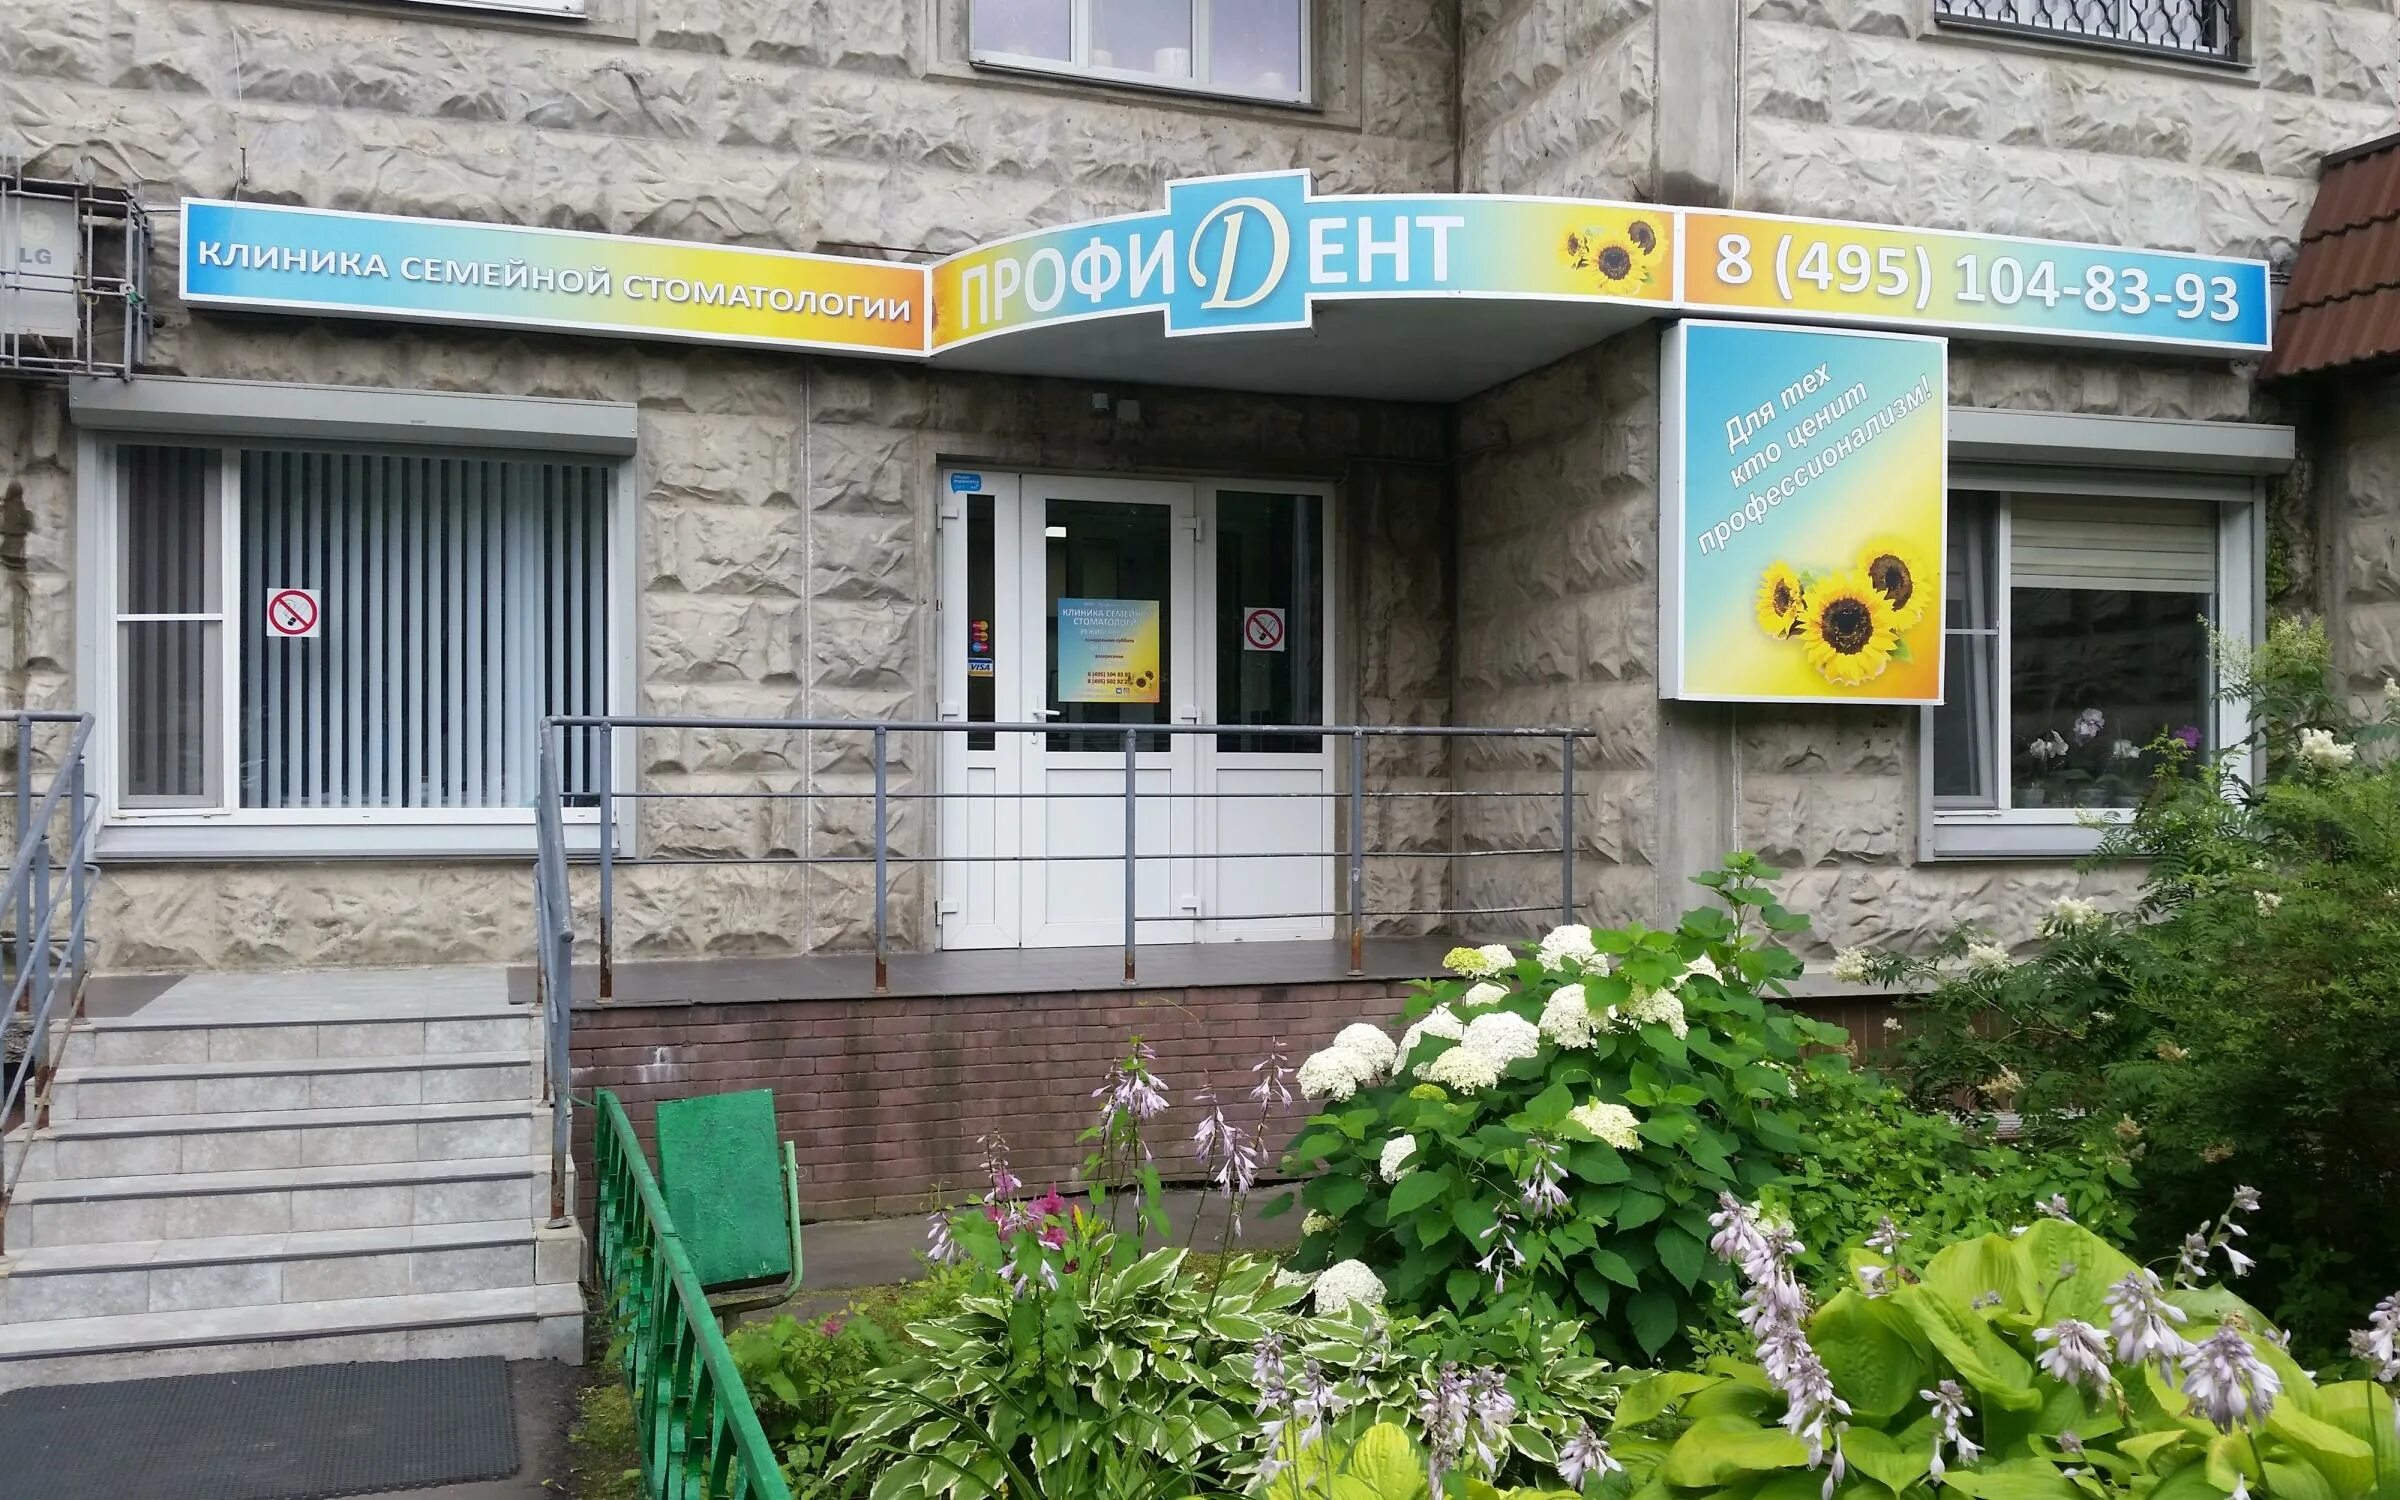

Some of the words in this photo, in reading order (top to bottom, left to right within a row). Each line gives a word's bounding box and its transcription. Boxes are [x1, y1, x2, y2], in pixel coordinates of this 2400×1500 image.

[19, 247, 52, 264] LG
[199, 241, 389, 279] КЛИНИКА
[400, 255, 611, 296] СЕМЕЙНОЙ
[622, 274, 911, 323] СТОМАТОЛОГИИ
[1715, 233, 1753, 285] 8
[1774, 233, 1933, 310] (495)
[1955, 253, 2240, 323] 104-83-93
[1725, 400, 1777, 456] Для
[1780, 361, 1832, 411] тех
[1729, 442, 1783, 489] кто
[1786, 381, 1868, 450] ценит
[1697, 373, 1934, 556] профессионализм!
[1062, 608, 1104, 617] КЛИНИКА
[971, 663, 991, 671] VISA
